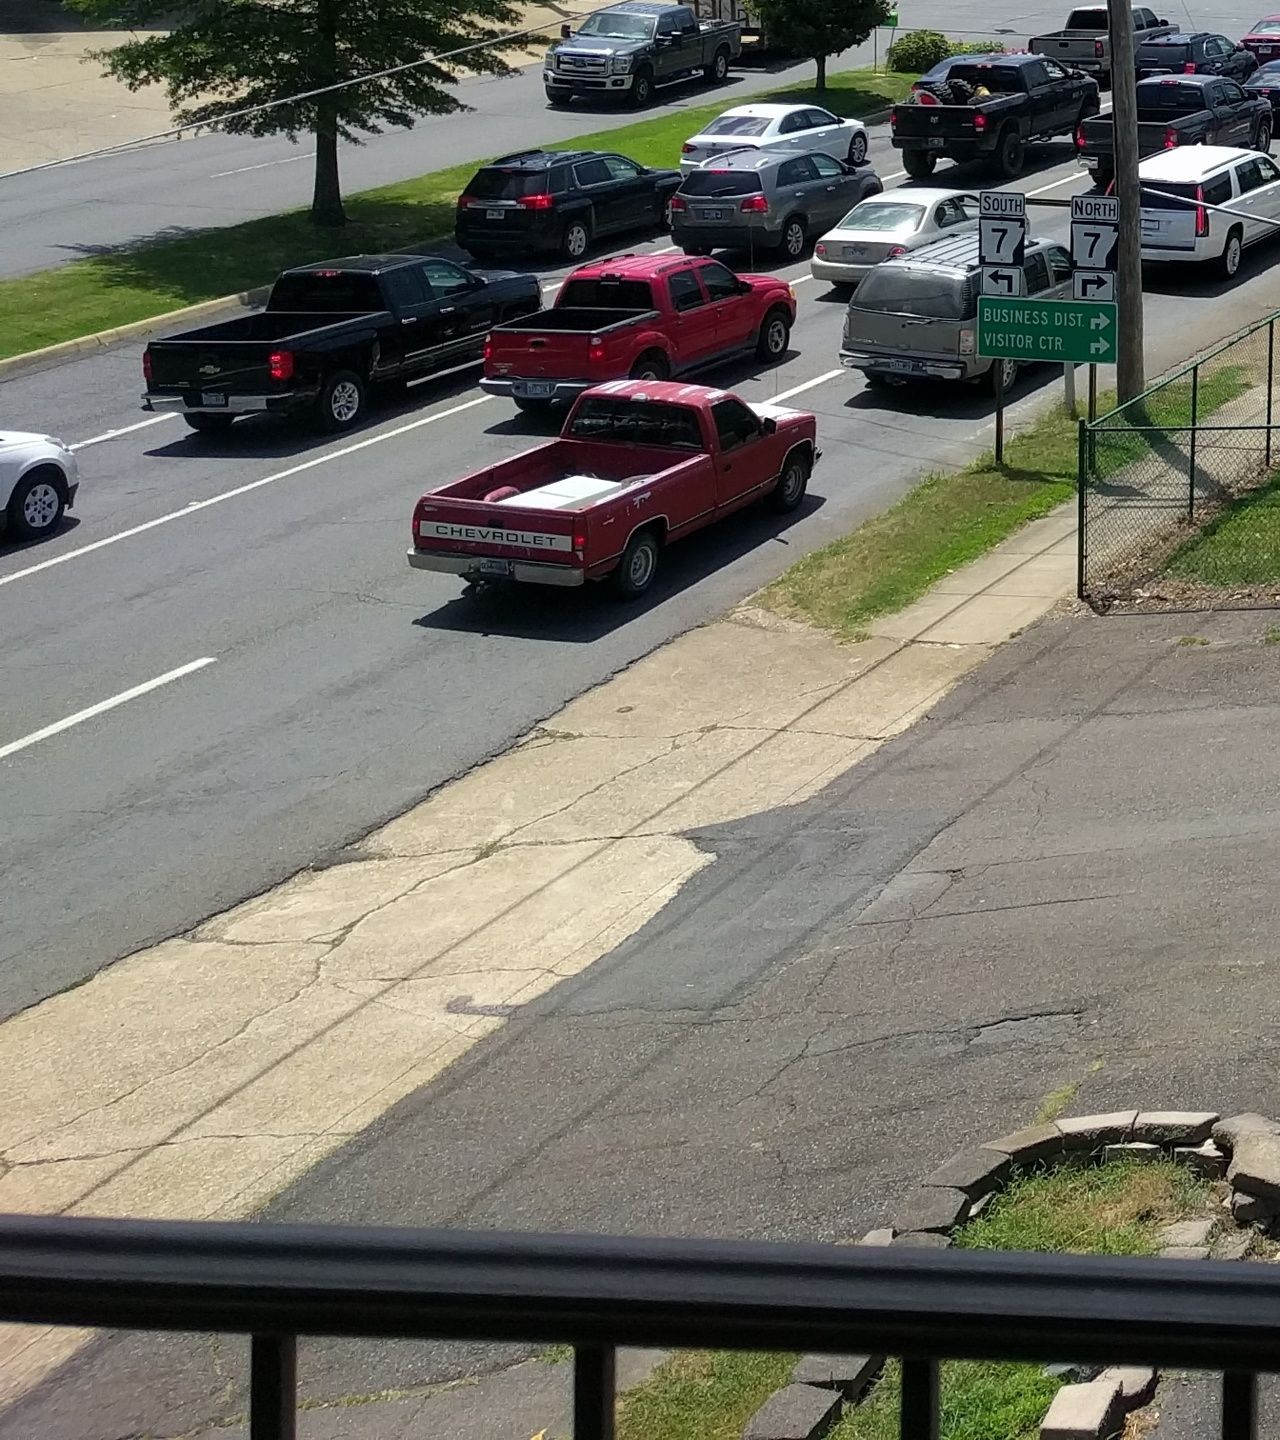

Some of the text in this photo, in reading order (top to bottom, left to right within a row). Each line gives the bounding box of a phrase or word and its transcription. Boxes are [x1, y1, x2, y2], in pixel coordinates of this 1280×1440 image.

[983, 195, 1022, 212] SOUTH
[1074, 200, 1116, 217] NORTH
[991, 228, 1008, 253] 7
[1083, 232, 1101, 258] 7
[984, 308, 1084, 327] BUSINESS DIST.
[984, 333, 1033, 349] VISITOR
[435, 525, 556, 547] CHEVROLET
